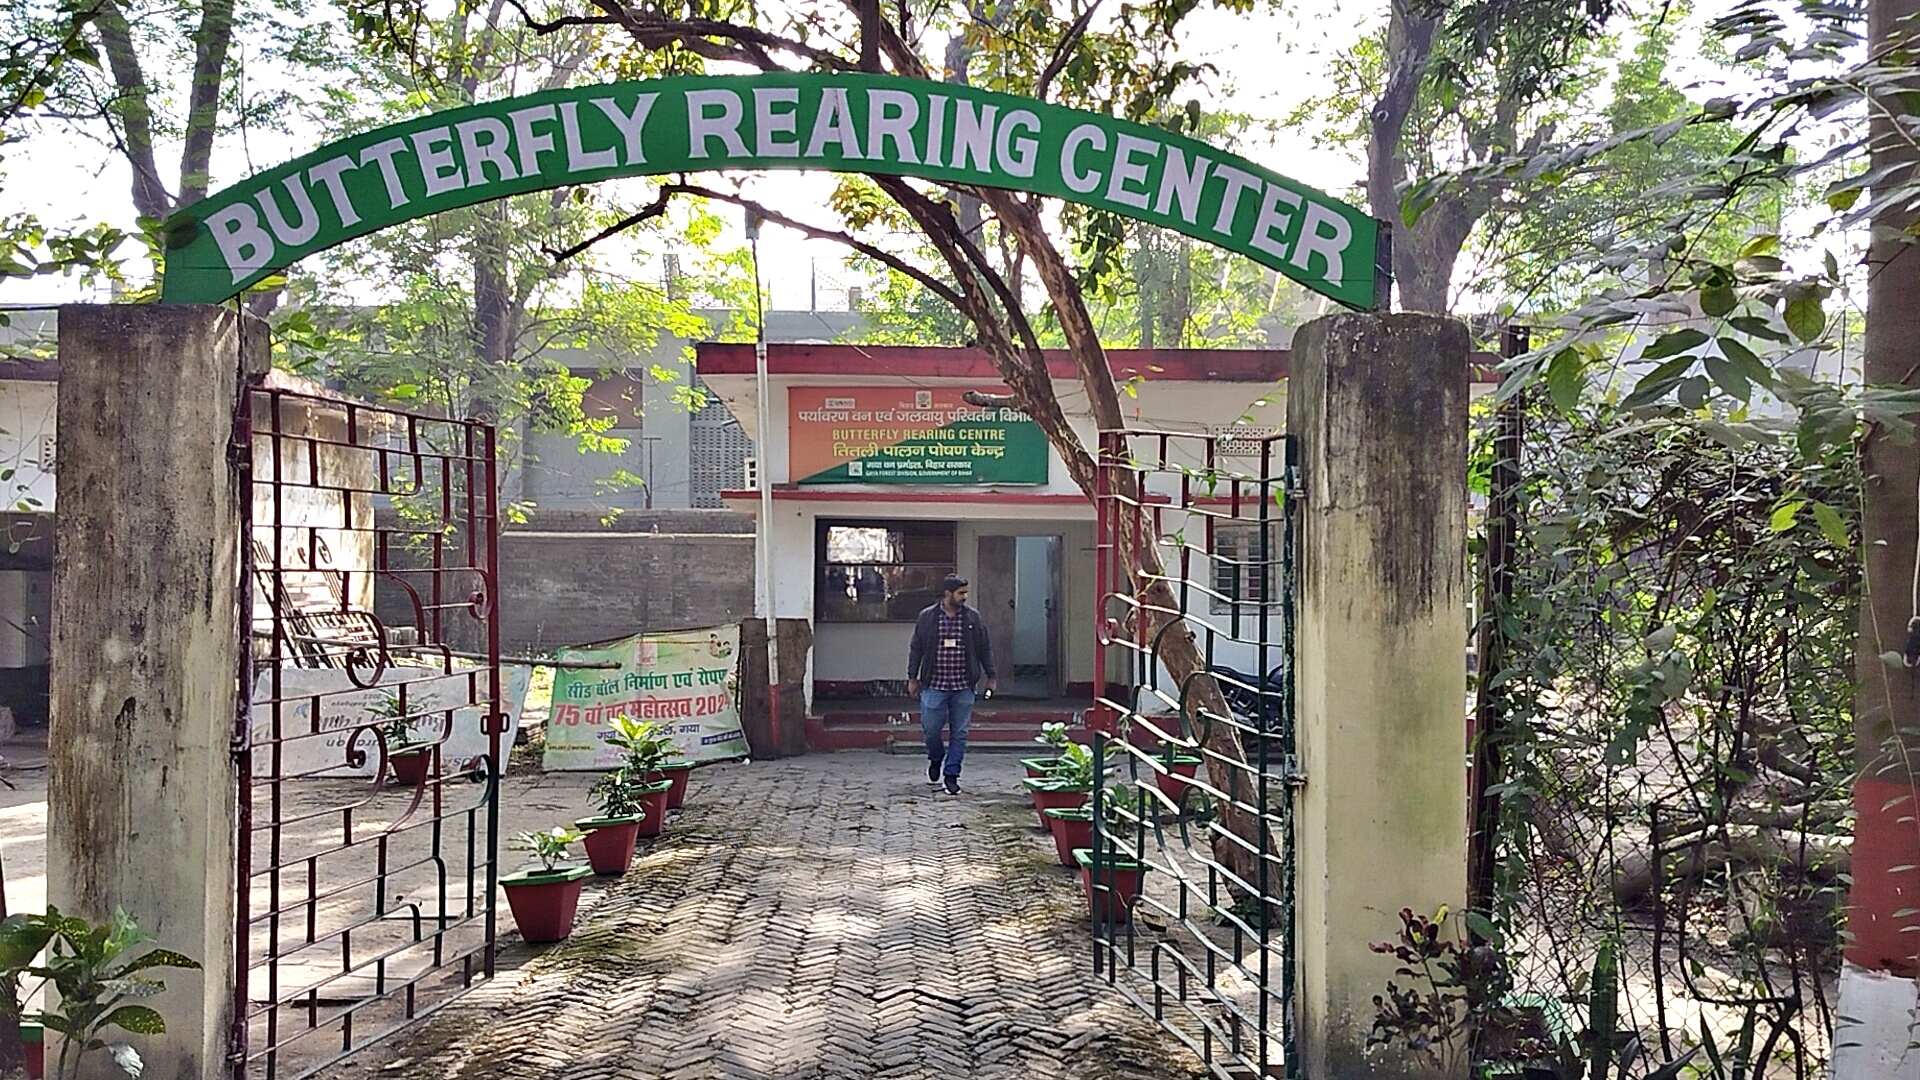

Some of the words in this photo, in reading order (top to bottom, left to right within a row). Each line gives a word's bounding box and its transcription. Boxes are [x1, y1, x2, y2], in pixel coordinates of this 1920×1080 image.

[203, 92, 661, 286] BUTTERFLY
[684, 87, 1042, 178] REARING
[1060, 124, 1352, 288] CENTER
[798, 406, 849, 422] पर्यावरण
[852, 411, 872, 422] वन
[875, 407, 896, 423] एवं
[896, 410, 944, 427] जलवायु
[946, 406, 996, 422] परिवर्तन
[832, 428, 899, 440] BUTTERFLY
[903, 428, 956, 440] REARING
[958, 428, 1006, 440] CENTRE
[833, 441, 879, 458] तितली
[883, 445, 926, 457] पालन
[928, 441, 968, 457] पोषण
[970, 441, 1006, 459] केन्द्र
[567, 681, 592, 698] सीड
[624, 671, 668, 691] निर्माण
[672, 667, 693, 688] एवं
[554, 703, 580, 727] 75
[584, 701, 604, 725] वां
[628, 694, 693, 719] महोत्सव
[679, 724, 700, 734] गया
